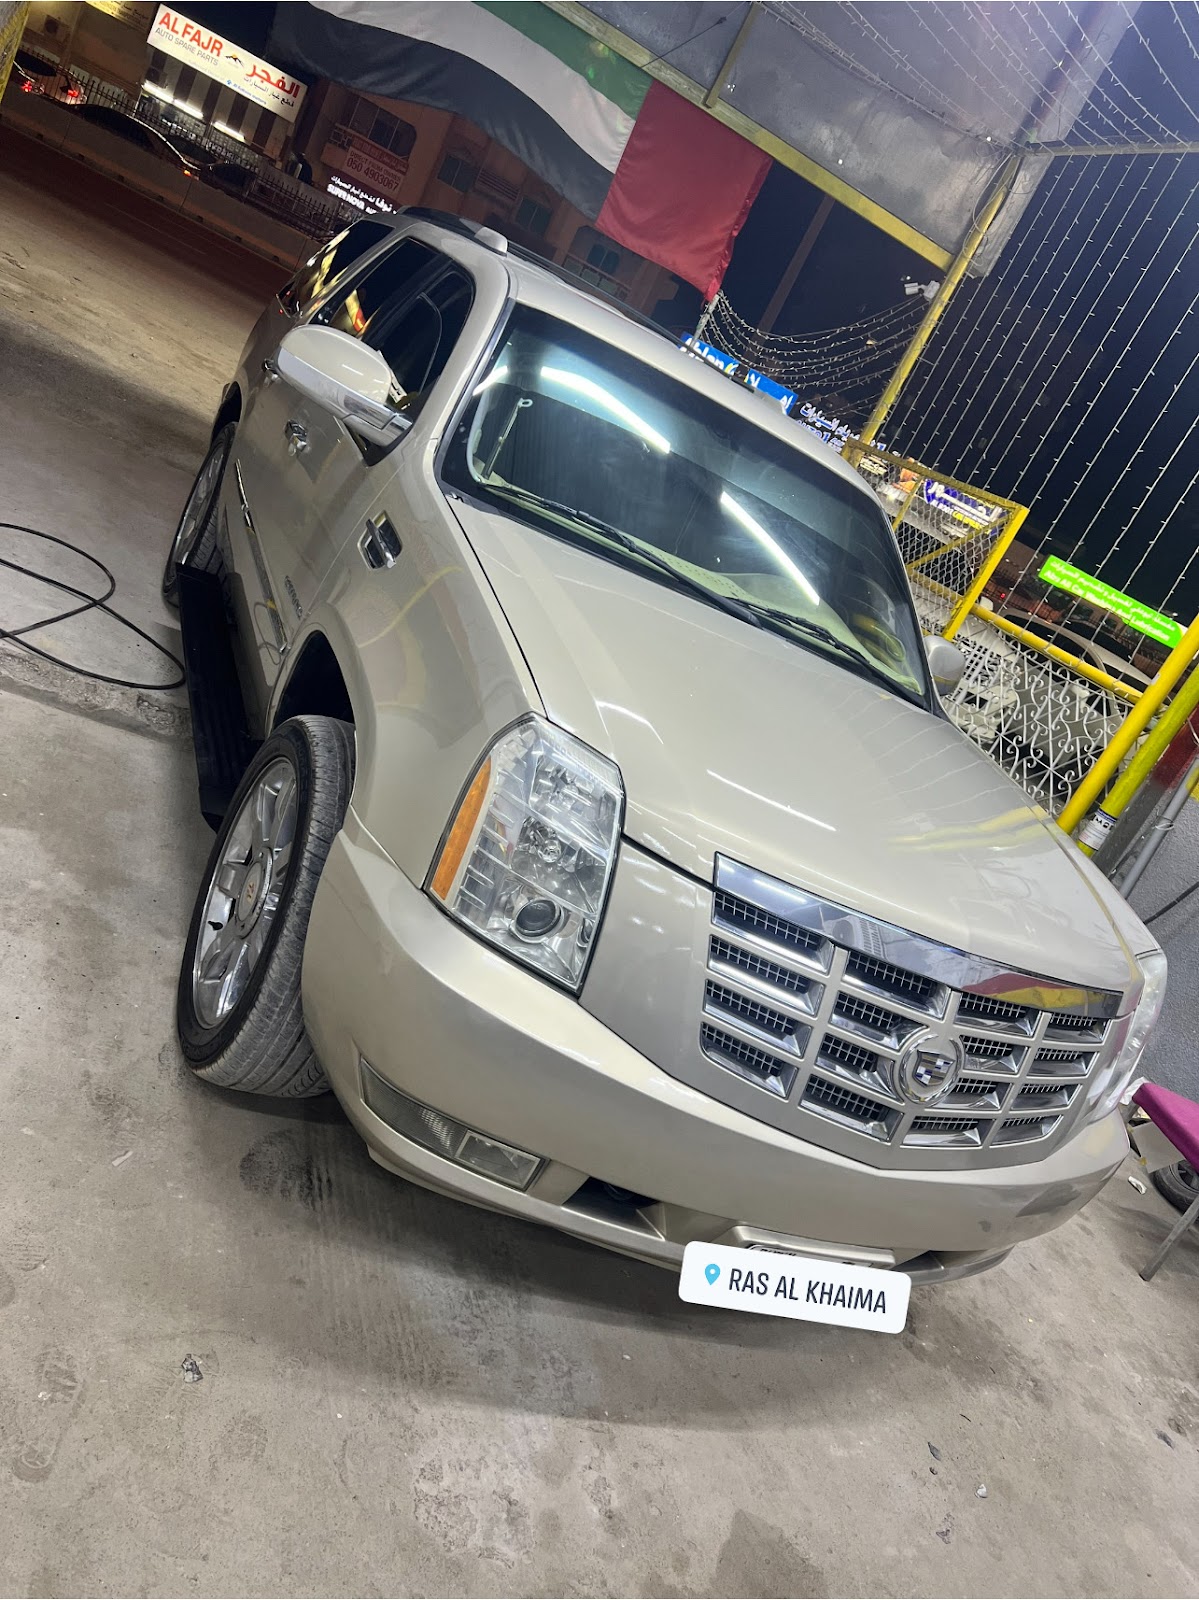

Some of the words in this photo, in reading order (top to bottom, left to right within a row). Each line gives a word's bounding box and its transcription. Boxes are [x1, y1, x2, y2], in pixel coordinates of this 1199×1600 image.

[155, 27, 173, 42] AUTO
[174, 37, 196, 55] SPARE
[196, 49, 219, 66] PARTS
[159, 12, 180, 34] AL
[181, 23, 223, 57] FAJR
[243, 76, 269, 93] السيارات
[246, 64, 300, 98] الفجر
[280, 97, 295, 107] قطع
[347, 158, 363, 172] 050
[364, 167, 399, 191] 4903067
[327, 183, 347, 200] SUPER
[346, 193, 365, 210] NOVA
